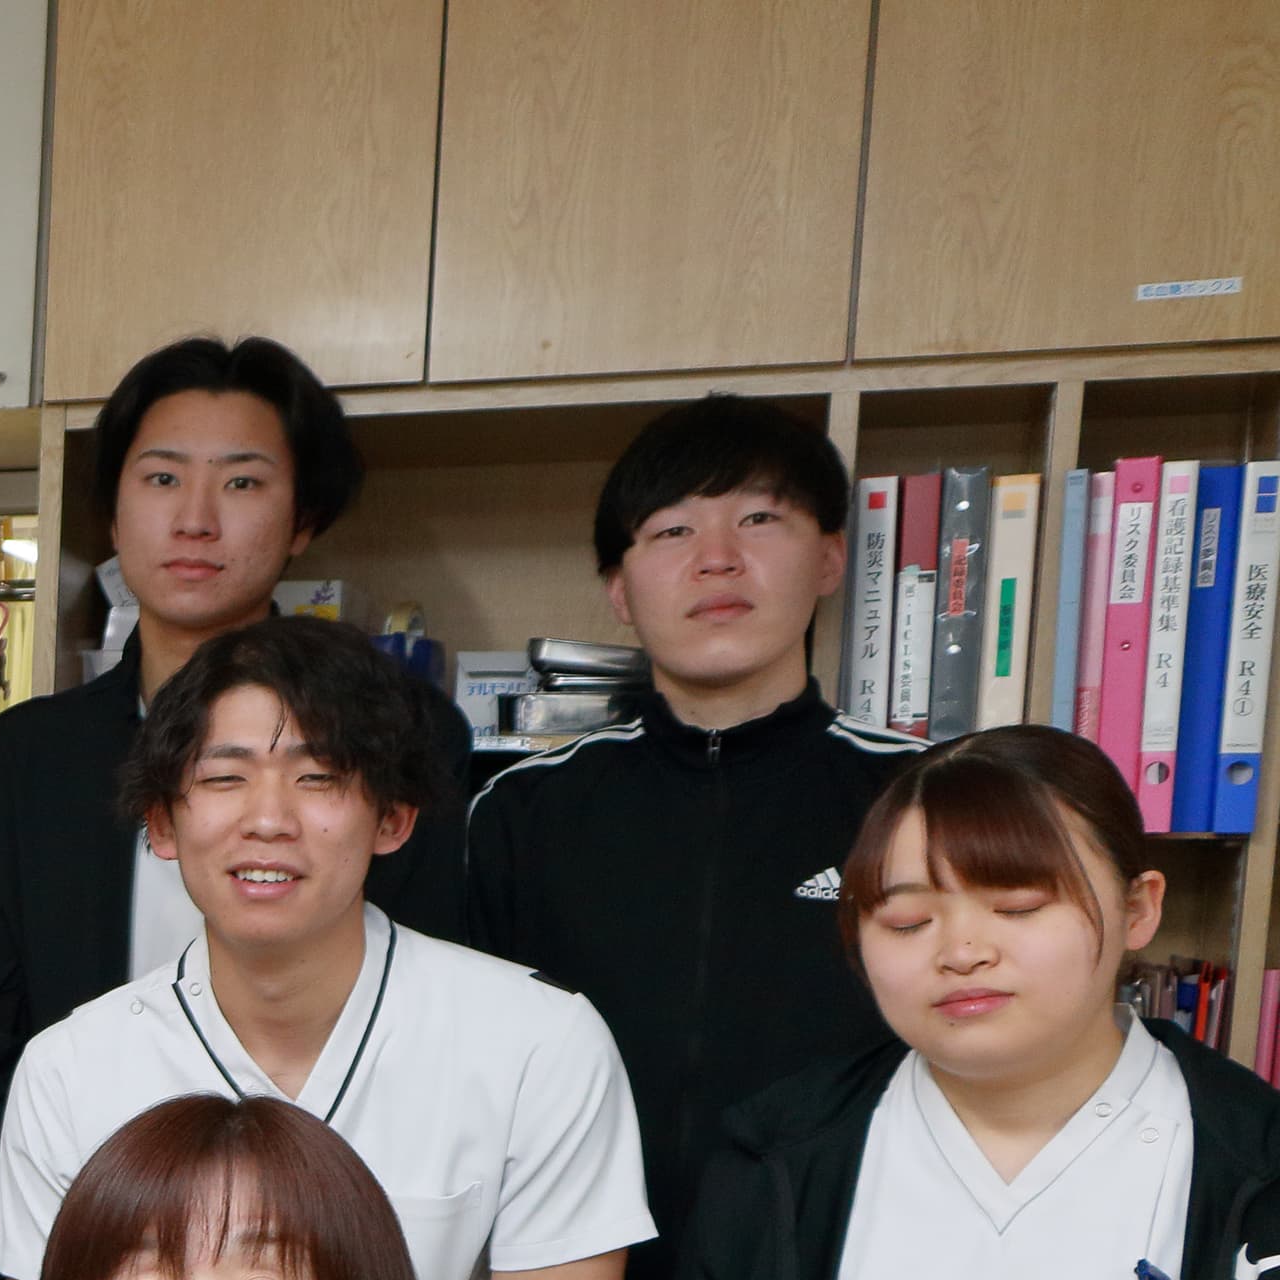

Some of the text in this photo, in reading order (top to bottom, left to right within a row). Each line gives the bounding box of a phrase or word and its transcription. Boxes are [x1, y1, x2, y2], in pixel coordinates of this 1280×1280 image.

[860, 531, 886, 660] 防災マニュアル
[1118, 506, 1142, 600] リスク委員会
[1158, 497, 1188, 633] 看護記録基準集
[1241, 563, 1270, 641] 医療安全
[796, 886, 841, 900] adida
